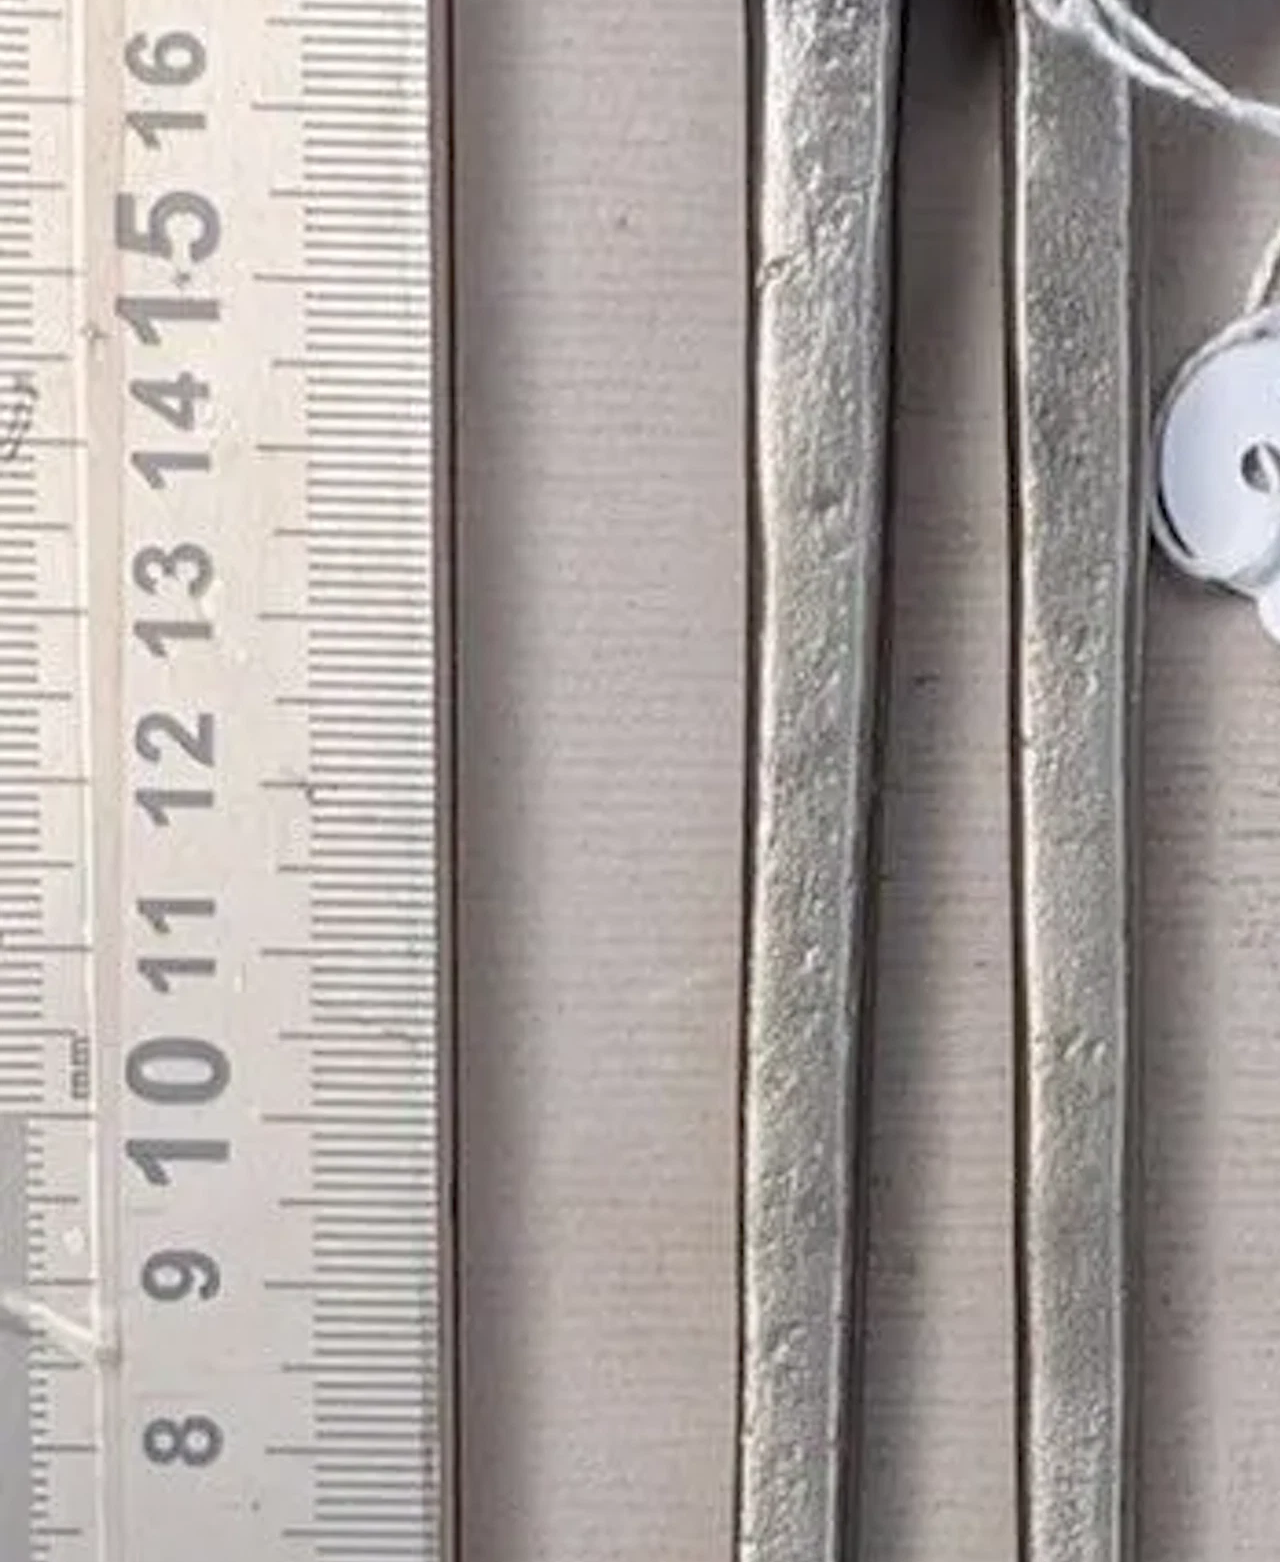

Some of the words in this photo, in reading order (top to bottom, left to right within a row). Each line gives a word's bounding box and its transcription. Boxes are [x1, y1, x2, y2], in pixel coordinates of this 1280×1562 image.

[125, 31, 207, 149] 16
[114, 190, 222, 346] 15
[130, 372, 212, 490] 14
[132, 543, 214, 659] 13
[134, 712, 215, 828] 12
[137, 896, 216, 994] 11
[124, 1037, 231, 1186] 10
[141, 1248, 222, 1303] 9
[142, 1416, 224, 1467] 8
